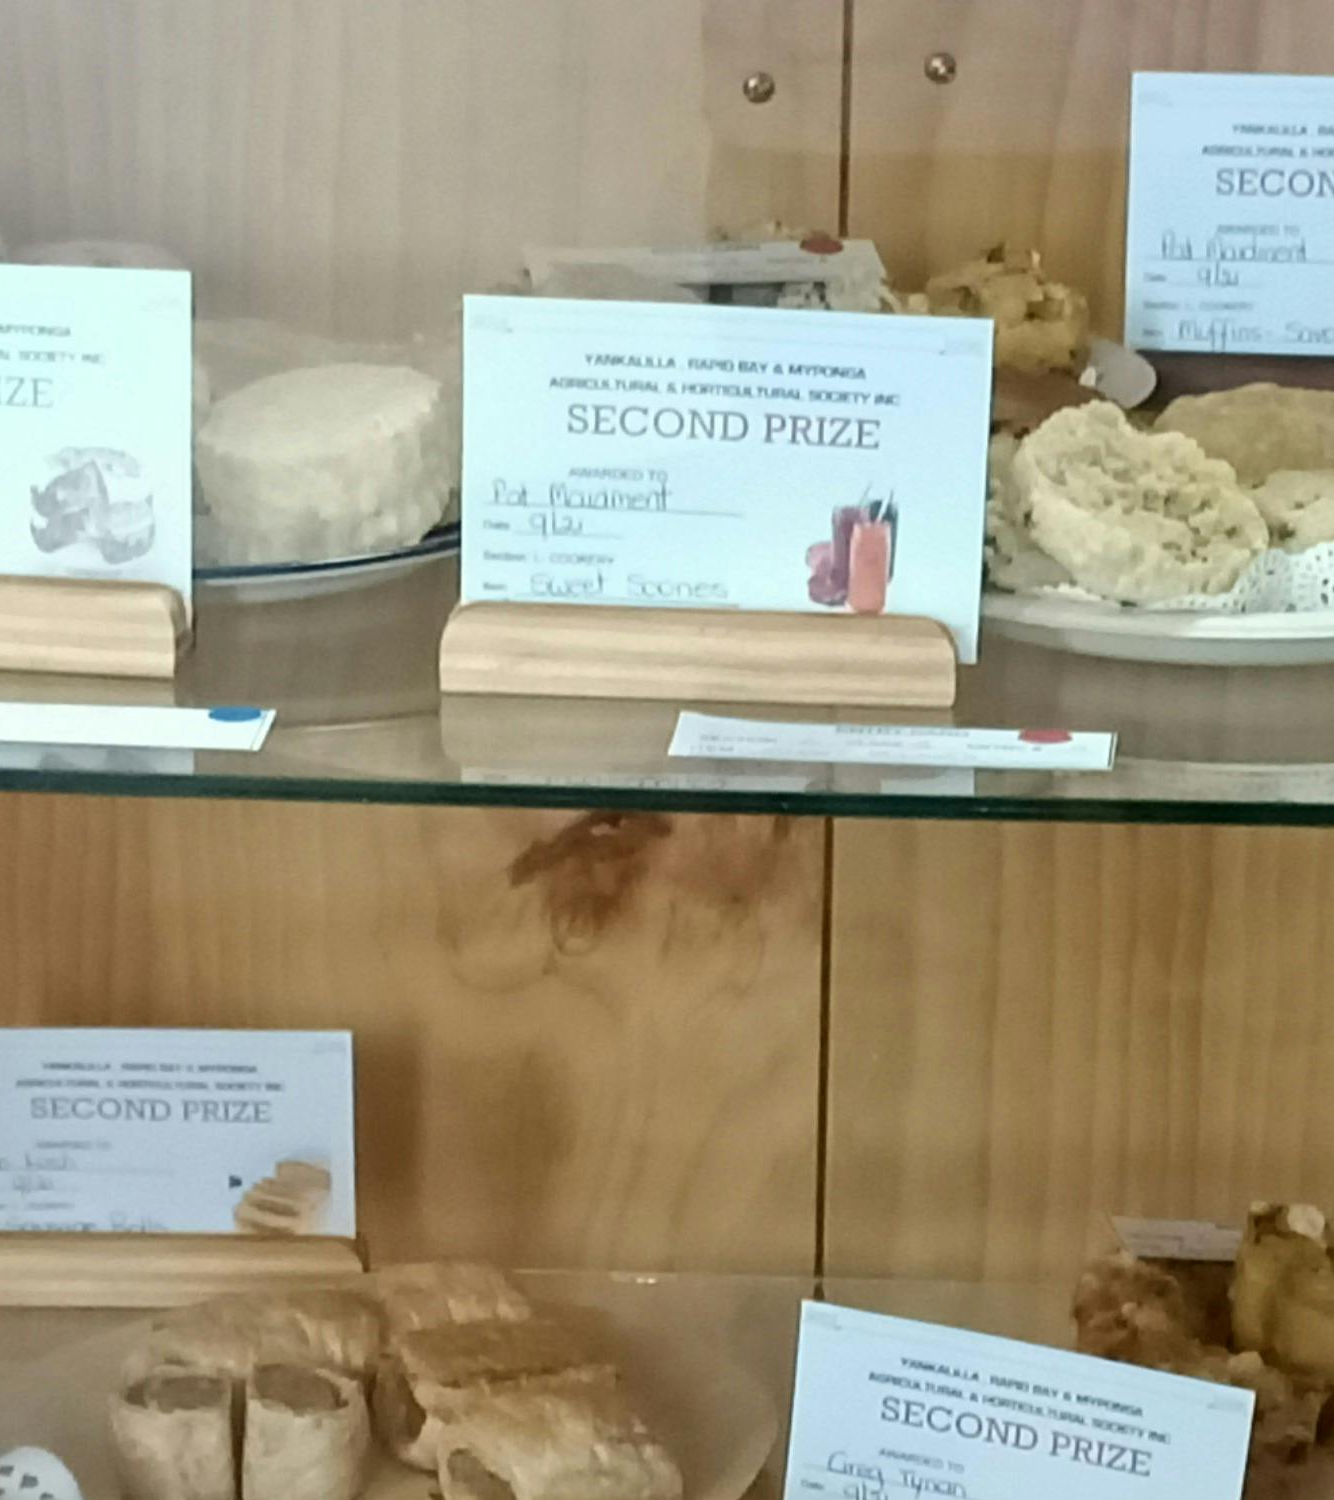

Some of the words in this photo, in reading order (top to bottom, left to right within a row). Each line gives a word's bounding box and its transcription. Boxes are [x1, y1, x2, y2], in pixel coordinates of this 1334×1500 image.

[739, 362, 768, 374] BAY
[568, 404, 749, 441] SECOND
[764, 415, 880, 449] PRIZE
[530, 575, 605, 596] Sweet
[31, 1097, 171, 1123] SECOND
[183, 1100, 272, 1124] PRIZE
[881, 1396, 1038, 1450] SECOND
[1050, 1431, 1152, 1477] PRIZE
